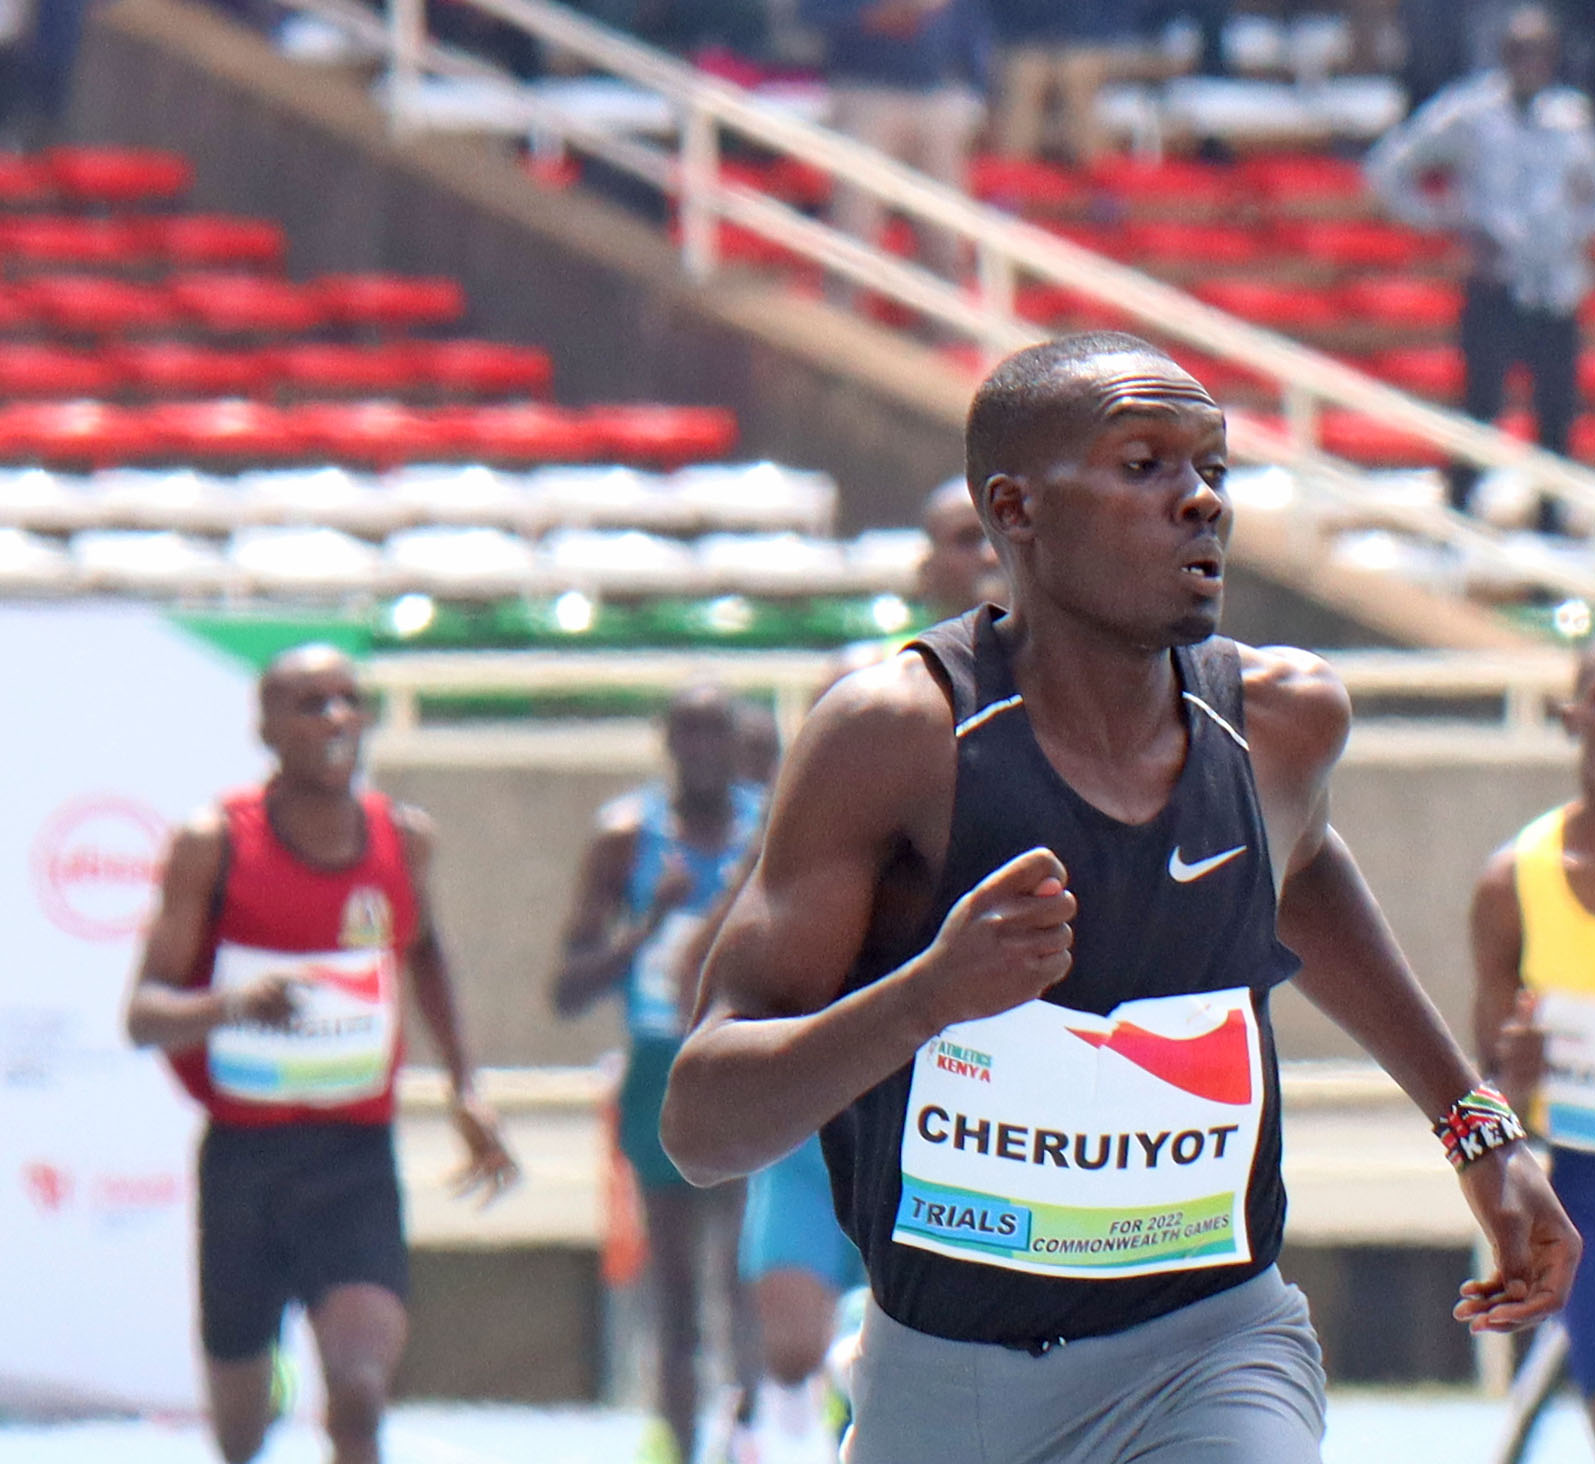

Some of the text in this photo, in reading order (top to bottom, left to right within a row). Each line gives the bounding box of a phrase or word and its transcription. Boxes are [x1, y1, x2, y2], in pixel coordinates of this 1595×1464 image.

[937, 1054, 991, 1083] KENYA
[917, 1104, 1240, 1171] CHERUIYOT
[911, 1196, 1018, 1237] TRIALS
[1031, 1213, 1230, 1254] COMMONWEALTH GAMES
[1108, 1212, 1184, 1236] FOR 2022
